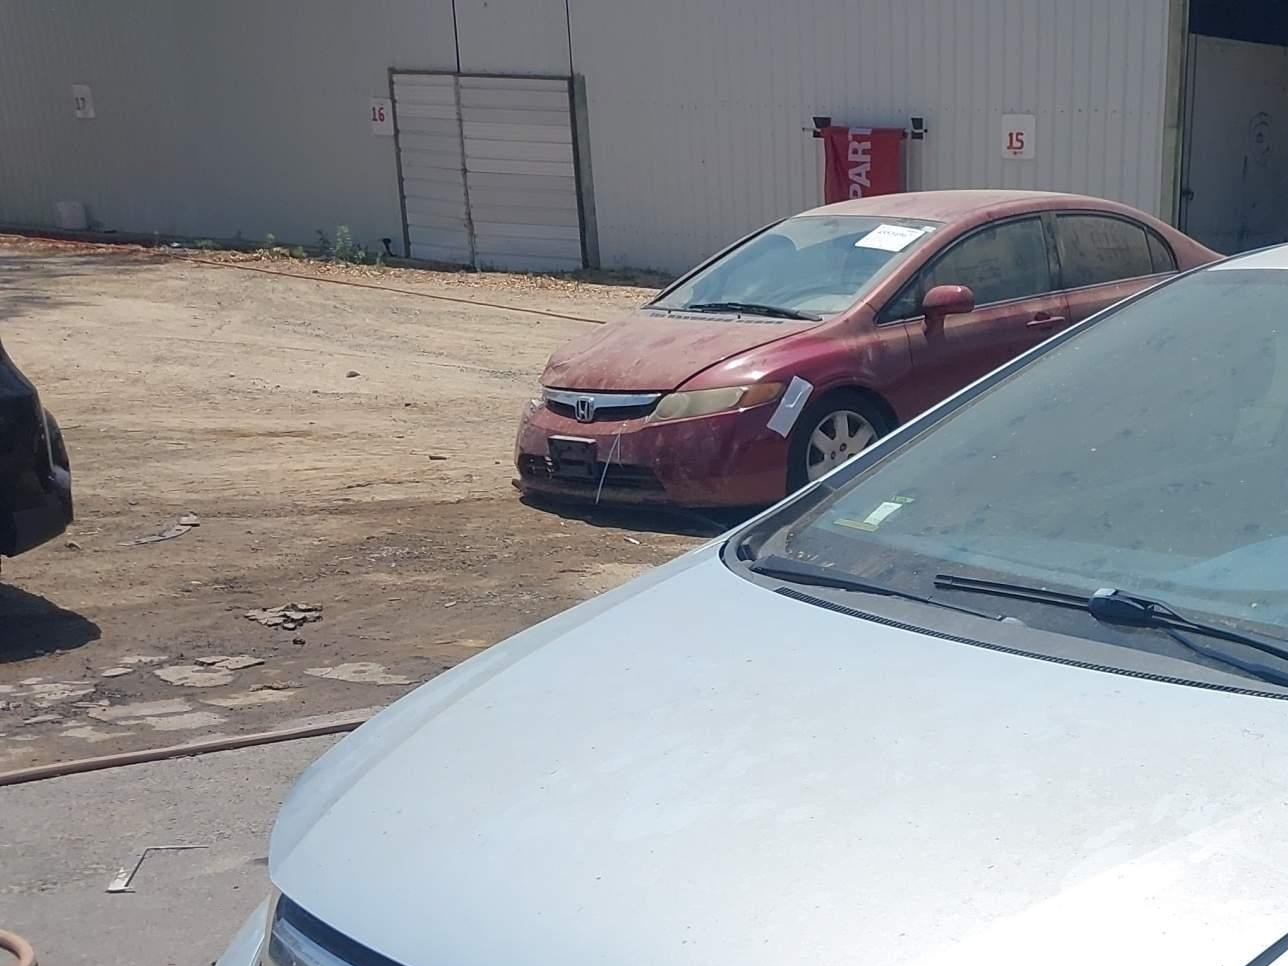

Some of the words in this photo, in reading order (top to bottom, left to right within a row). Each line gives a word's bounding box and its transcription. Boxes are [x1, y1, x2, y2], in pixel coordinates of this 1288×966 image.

[75, 97, 86, 110] 17
[371, 106, 385, 122] 16
[1007, 131, 1025, 150] 15
